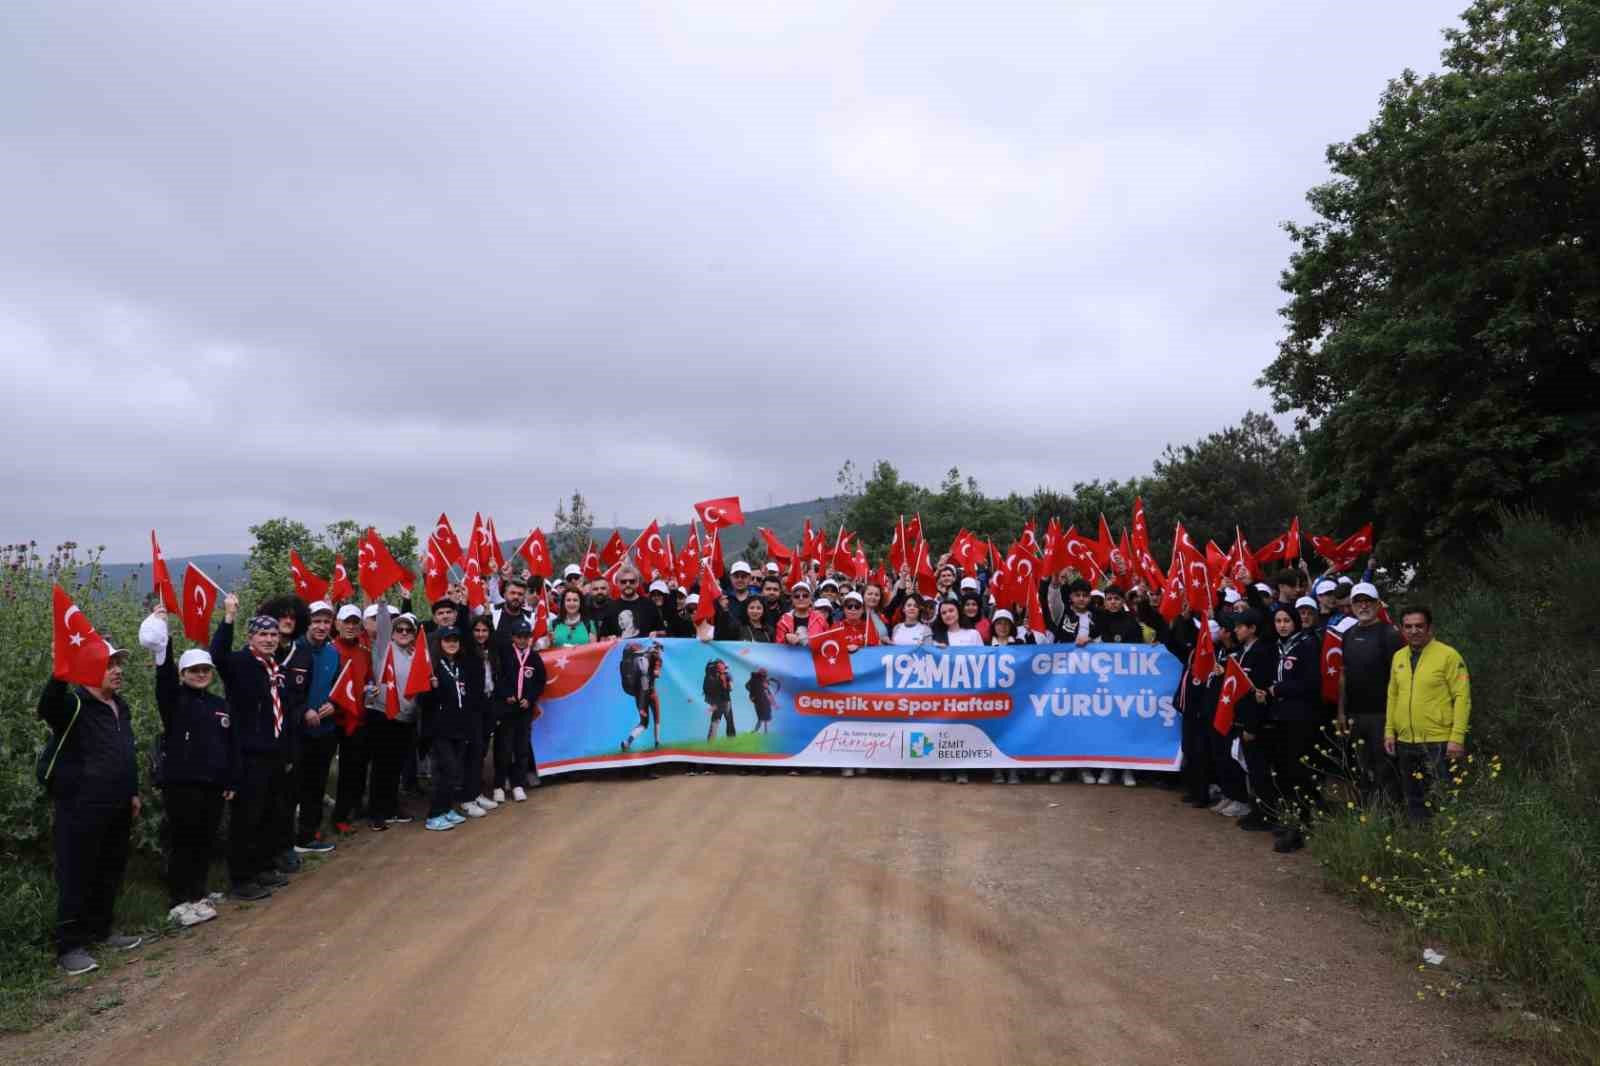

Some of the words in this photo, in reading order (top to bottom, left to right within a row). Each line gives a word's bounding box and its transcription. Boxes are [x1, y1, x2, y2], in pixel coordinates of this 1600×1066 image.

[881, 654, 914, 689] 19
[924, 654, 1016, 689] MAYIS
[1031, 647, 1161, 683] GENÇLİK
[798, 695, 869, 715] Gençlik
[872, 700, 895, 711] ve
[898, 699, 940, 716] Spor
[943, 697, 1010, 712] Haftası
[938, 738, 964, 749] İZMİT
[938, 748, 993, 759] BELEDİYESİ
